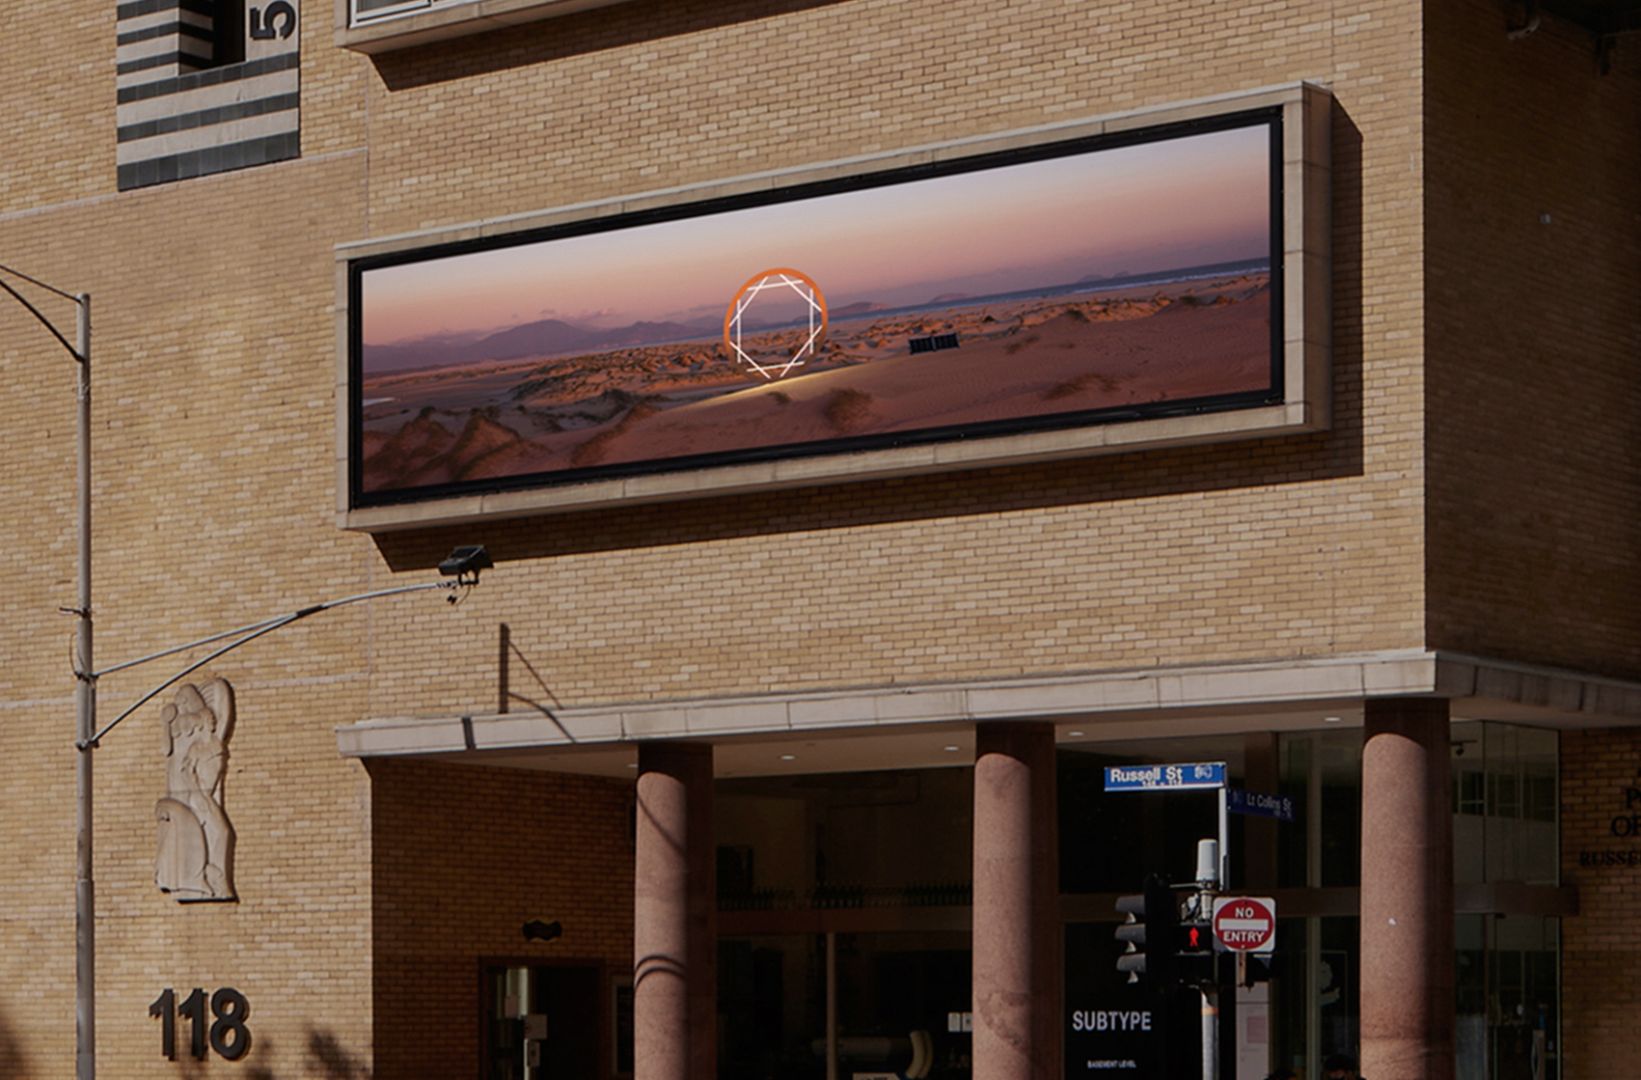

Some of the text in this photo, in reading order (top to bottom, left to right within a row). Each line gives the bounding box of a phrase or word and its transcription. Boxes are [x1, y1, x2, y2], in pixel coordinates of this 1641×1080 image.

[250, 0, 296, 40] 5
[1110, 766, 1183, 783] Russell St
[1256, 794, 1281, 810] Collins
[1234, 907, 1255, 918] NO
[1223, 931, 1265, 943] ENTRY
[149, 987, 252, 1062] 118
[1072, 1010, 1152, 1031] SUBTYPE
